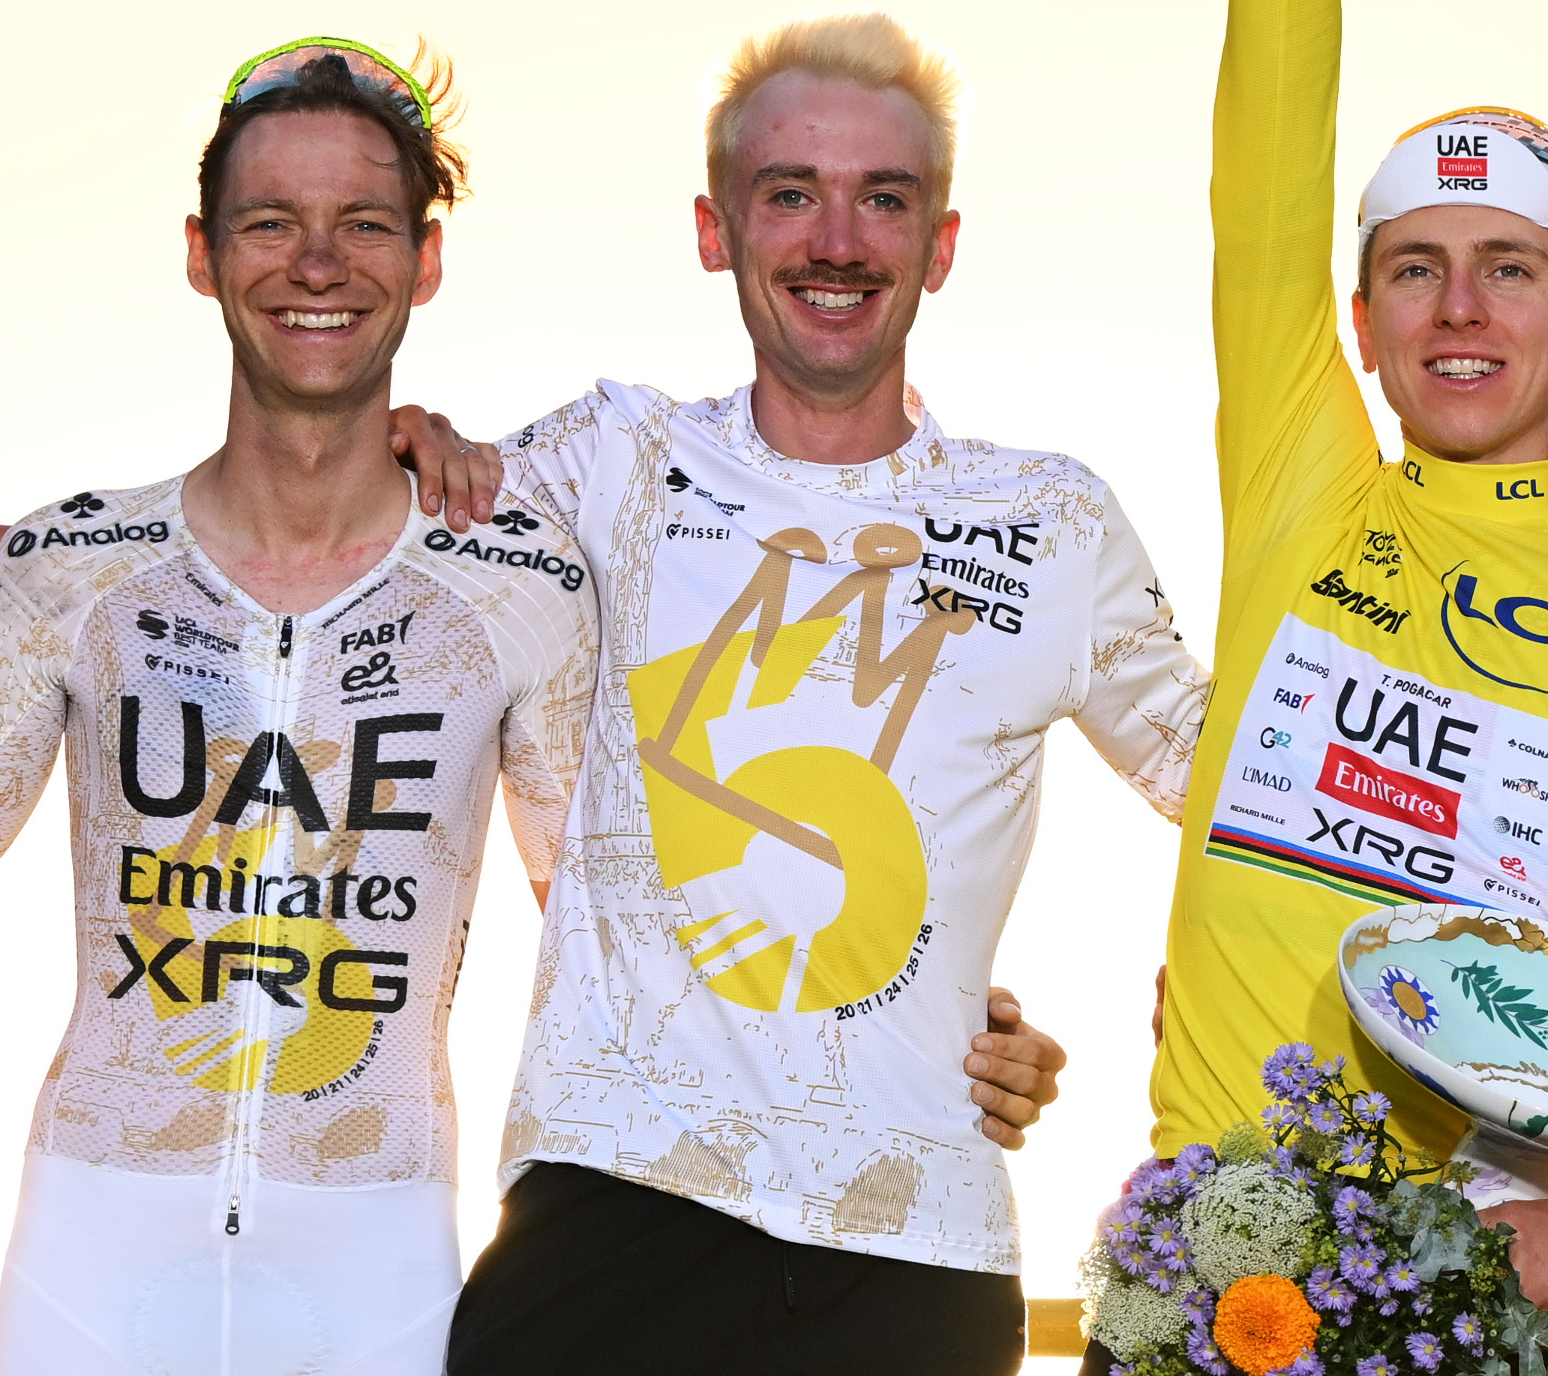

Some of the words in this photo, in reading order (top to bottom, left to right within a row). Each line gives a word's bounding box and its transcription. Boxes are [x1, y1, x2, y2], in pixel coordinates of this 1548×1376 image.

[1437, 135, 1488, 156] UAE
[1442, 162, 1482, 172] Emirates
[1437, 178, 1488, 191] XRG
[1496, 479, 1544, 500] LCL
[41, 518, 169, 551] Analog
[681, 527, 730, 540] PISSEI
[925, 517, 1040, 566] UAE
[455, 538, 586, 592] Analog
[922, 552, 1030, 599] Emirates
[184, 573, 223, 608] Emirates
[911, 578, 1024, 635] XRG
[174, 616, 196, 628] UCI
[174, 624, 240, 652] WORLDTOUR
[174, 632, 197, 645] BEST
[198, 637, 227, 655] TEAM
[164, 660, 230, 685] PISSEI
[1294, 656, 1330, 679] Analog
[380, 688, 399, 700] and
[1381, 674, 1390, 688] T.
[1393, 679, 1452, 709] POGACAR
[1260, 727, 1292, 749] G42
[1335, 677, 1479, 783] UAE
[119, 696, 443, 832] UAE
[1242, 766, 1291, 792] L'IMAD
[1334, 760, 1445, 823] Emirates
[1229, 804, 1260, 818] RICHARD
[1261, 812, 1285, 825] MILLE
[1305, 807, 1455, 884] XRG
[1512, 822, 1543, 845] IHC
[119, 845, 418, 922] Emirates
[1498, 885, 1540, 906] PISSEI
[108, 934, 409, 1013] XRG
[834, 1004, 855, 1021] 20
[857, 999, 872, 1015] 21
[885, 981, 902, 1002] 24
[906, 955, 919, 977] 25
[917, 923, 932, 945] 26
[302, 1089, 320, 1102] 20
[328, 1079, 345, 1093] 21
[350, 1063, 365, 1079] 24
[365, 1043, 379, 1058] 25
[373, 1020, 384, 1035] 26
